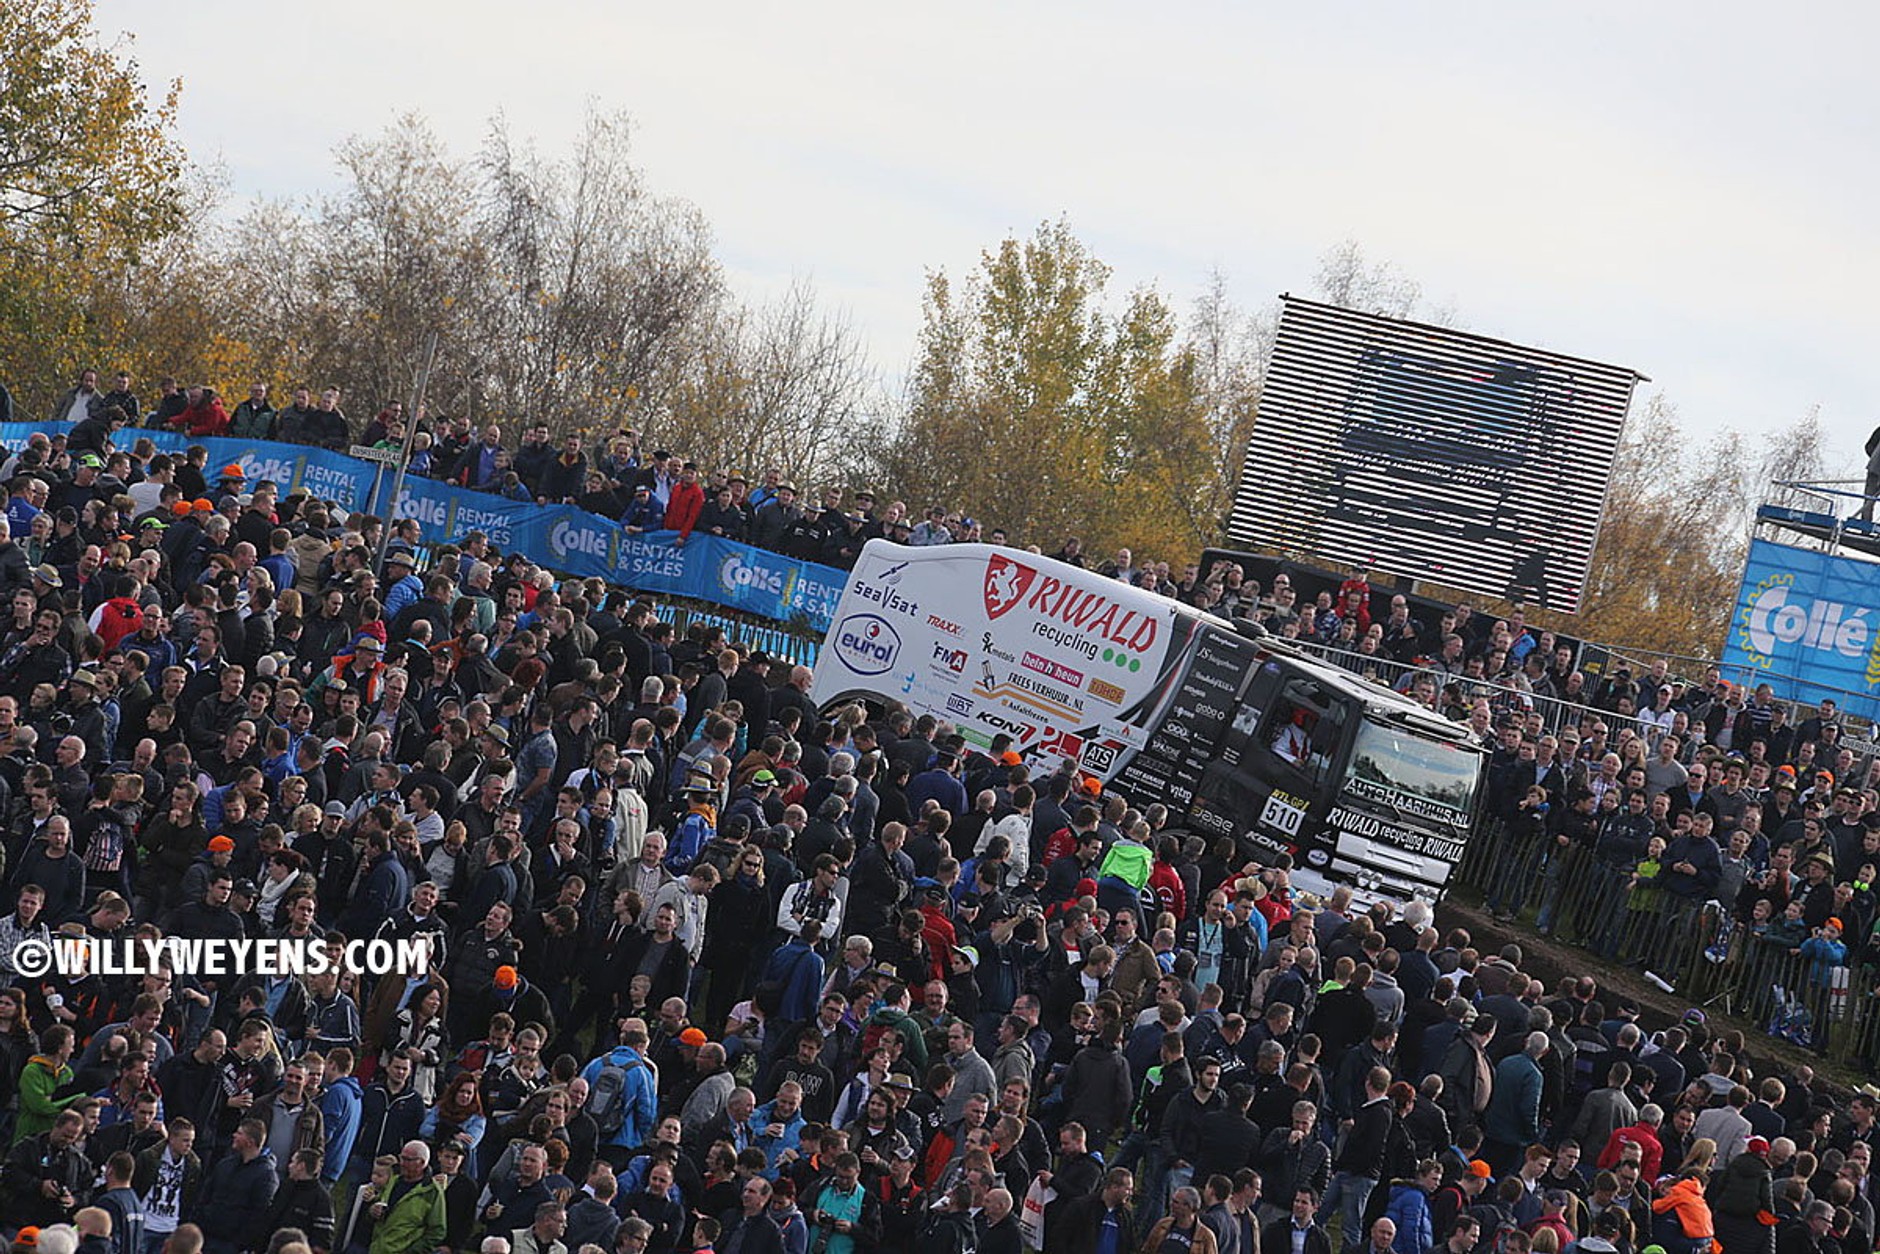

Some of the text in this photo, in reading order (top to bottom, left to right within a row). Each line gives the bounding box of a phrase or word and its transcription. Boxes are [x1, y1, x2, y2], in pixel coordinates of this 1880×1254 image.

[305, 464, 356, 490] RENTAL
[457, 507, 512, 529] RENTAL
[551, 520, 608, 558] Collé
[621, 539, 686, 561] RENTAL
[618, 555, 685, 578] & SALES
[722, 557, 783, 594] Collé
[792, 594, 804, 609] &
[1027, 576, 1158, 653] RIWALD
[1749, 585, 1872, 658] Collé
[841, 632, 894, 663] eurol
[1032, 621, 1099, 661] recycling
[1006, 673, 1032, 691] FREES
[1086, 744, 1113, 766] ATS
[1265, 800, 1300, 831] 510
[1325, 807, 1381, 838] RIWALD
[1380, 825, 1425, 851] recycling
